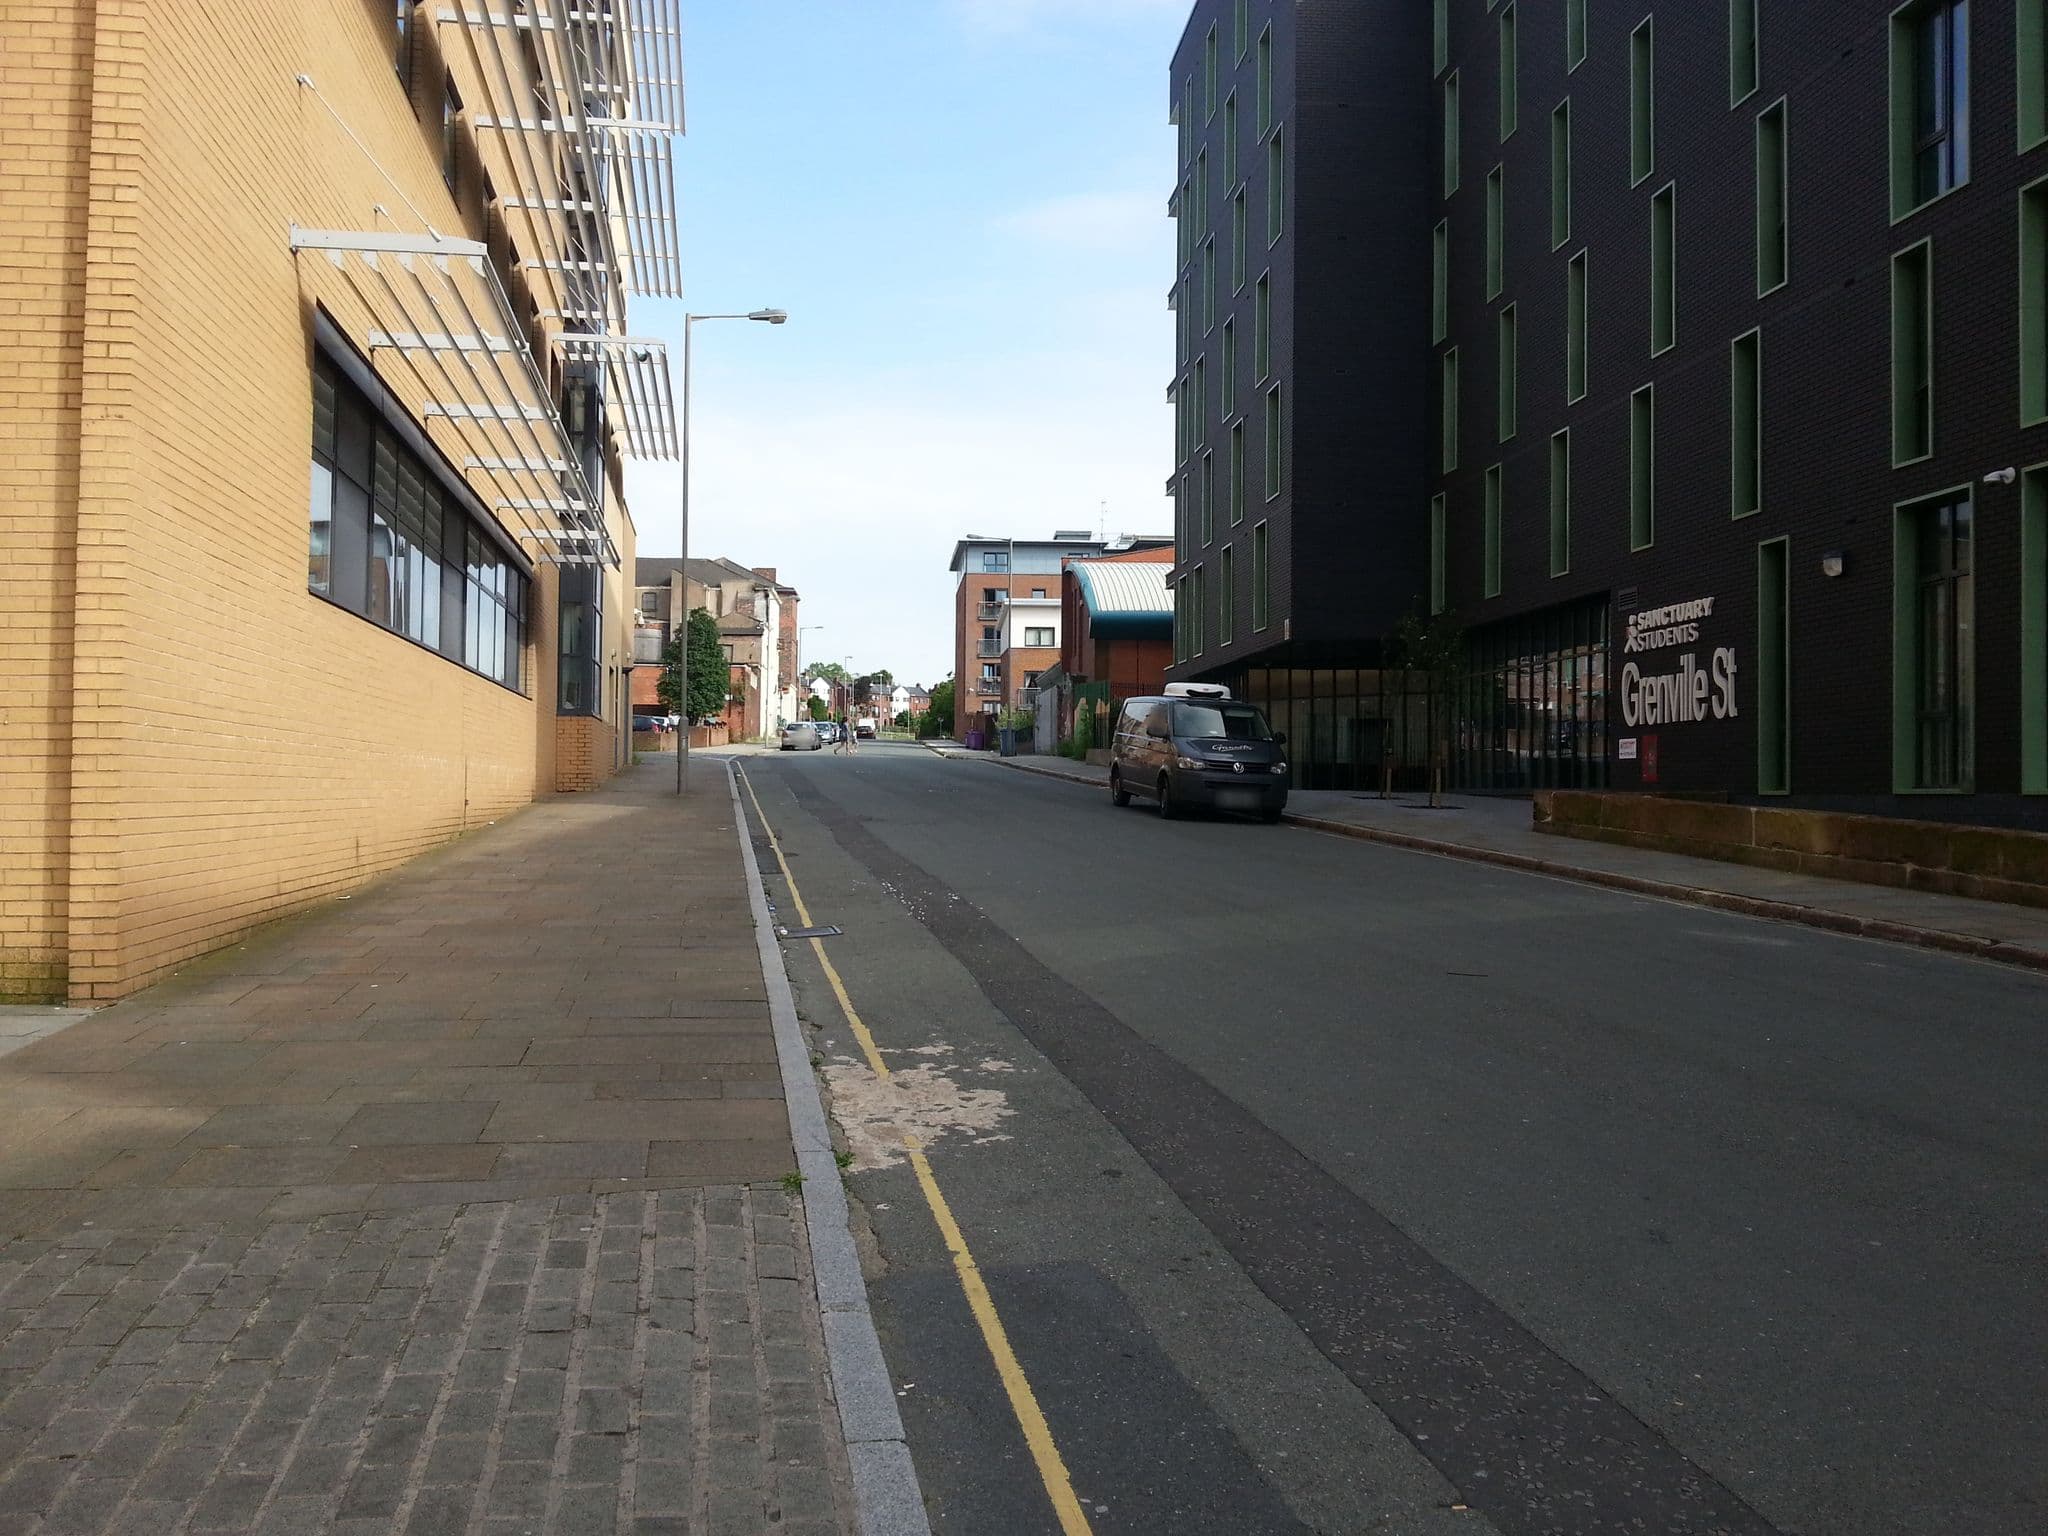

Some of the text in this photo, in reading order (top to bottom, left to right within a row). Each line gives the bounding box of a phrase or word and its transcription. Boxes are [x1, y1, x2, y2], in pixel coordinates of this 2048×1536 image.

[1637, 597, 1715, 630] SANCTUARY
[1637, 622, 1699, 652] STUDENTS
[1621, 647, 1738, 727] Grenville St
